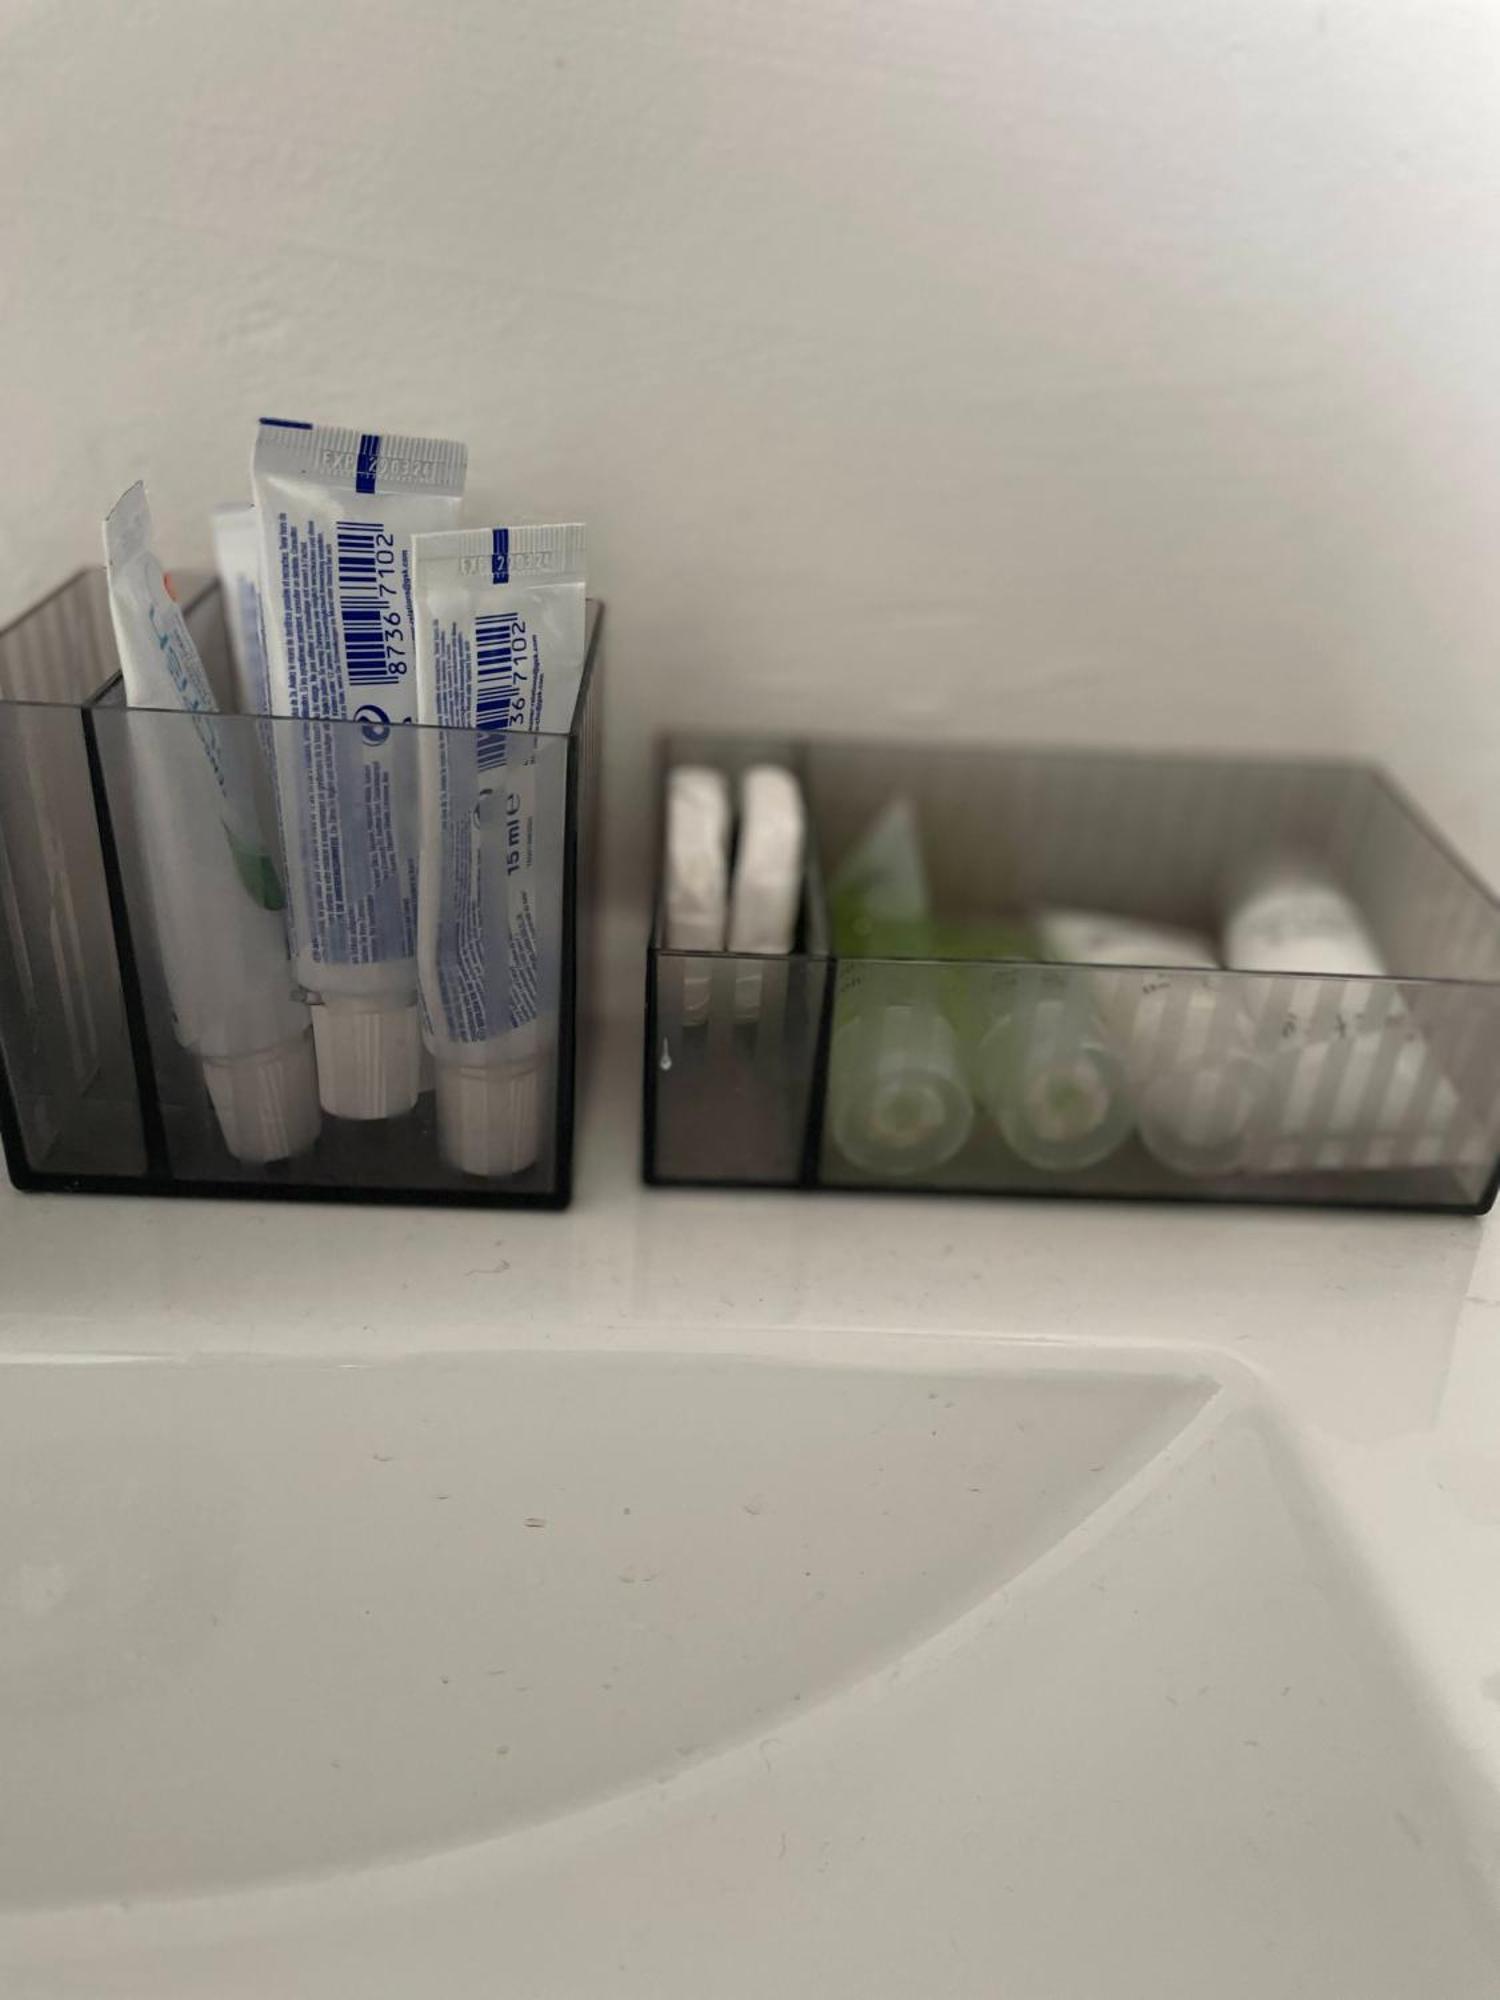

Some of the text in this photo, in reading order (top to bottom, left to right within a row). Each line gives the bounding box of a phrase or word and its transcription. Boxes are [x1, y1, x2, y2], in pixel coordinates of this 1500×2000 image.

[376, 533, 407, 675] 8736 7102
[511, 620, 528, 684] 7102
[506, 818, 520, 845] ml
[506, 851, 520, 876] 15
